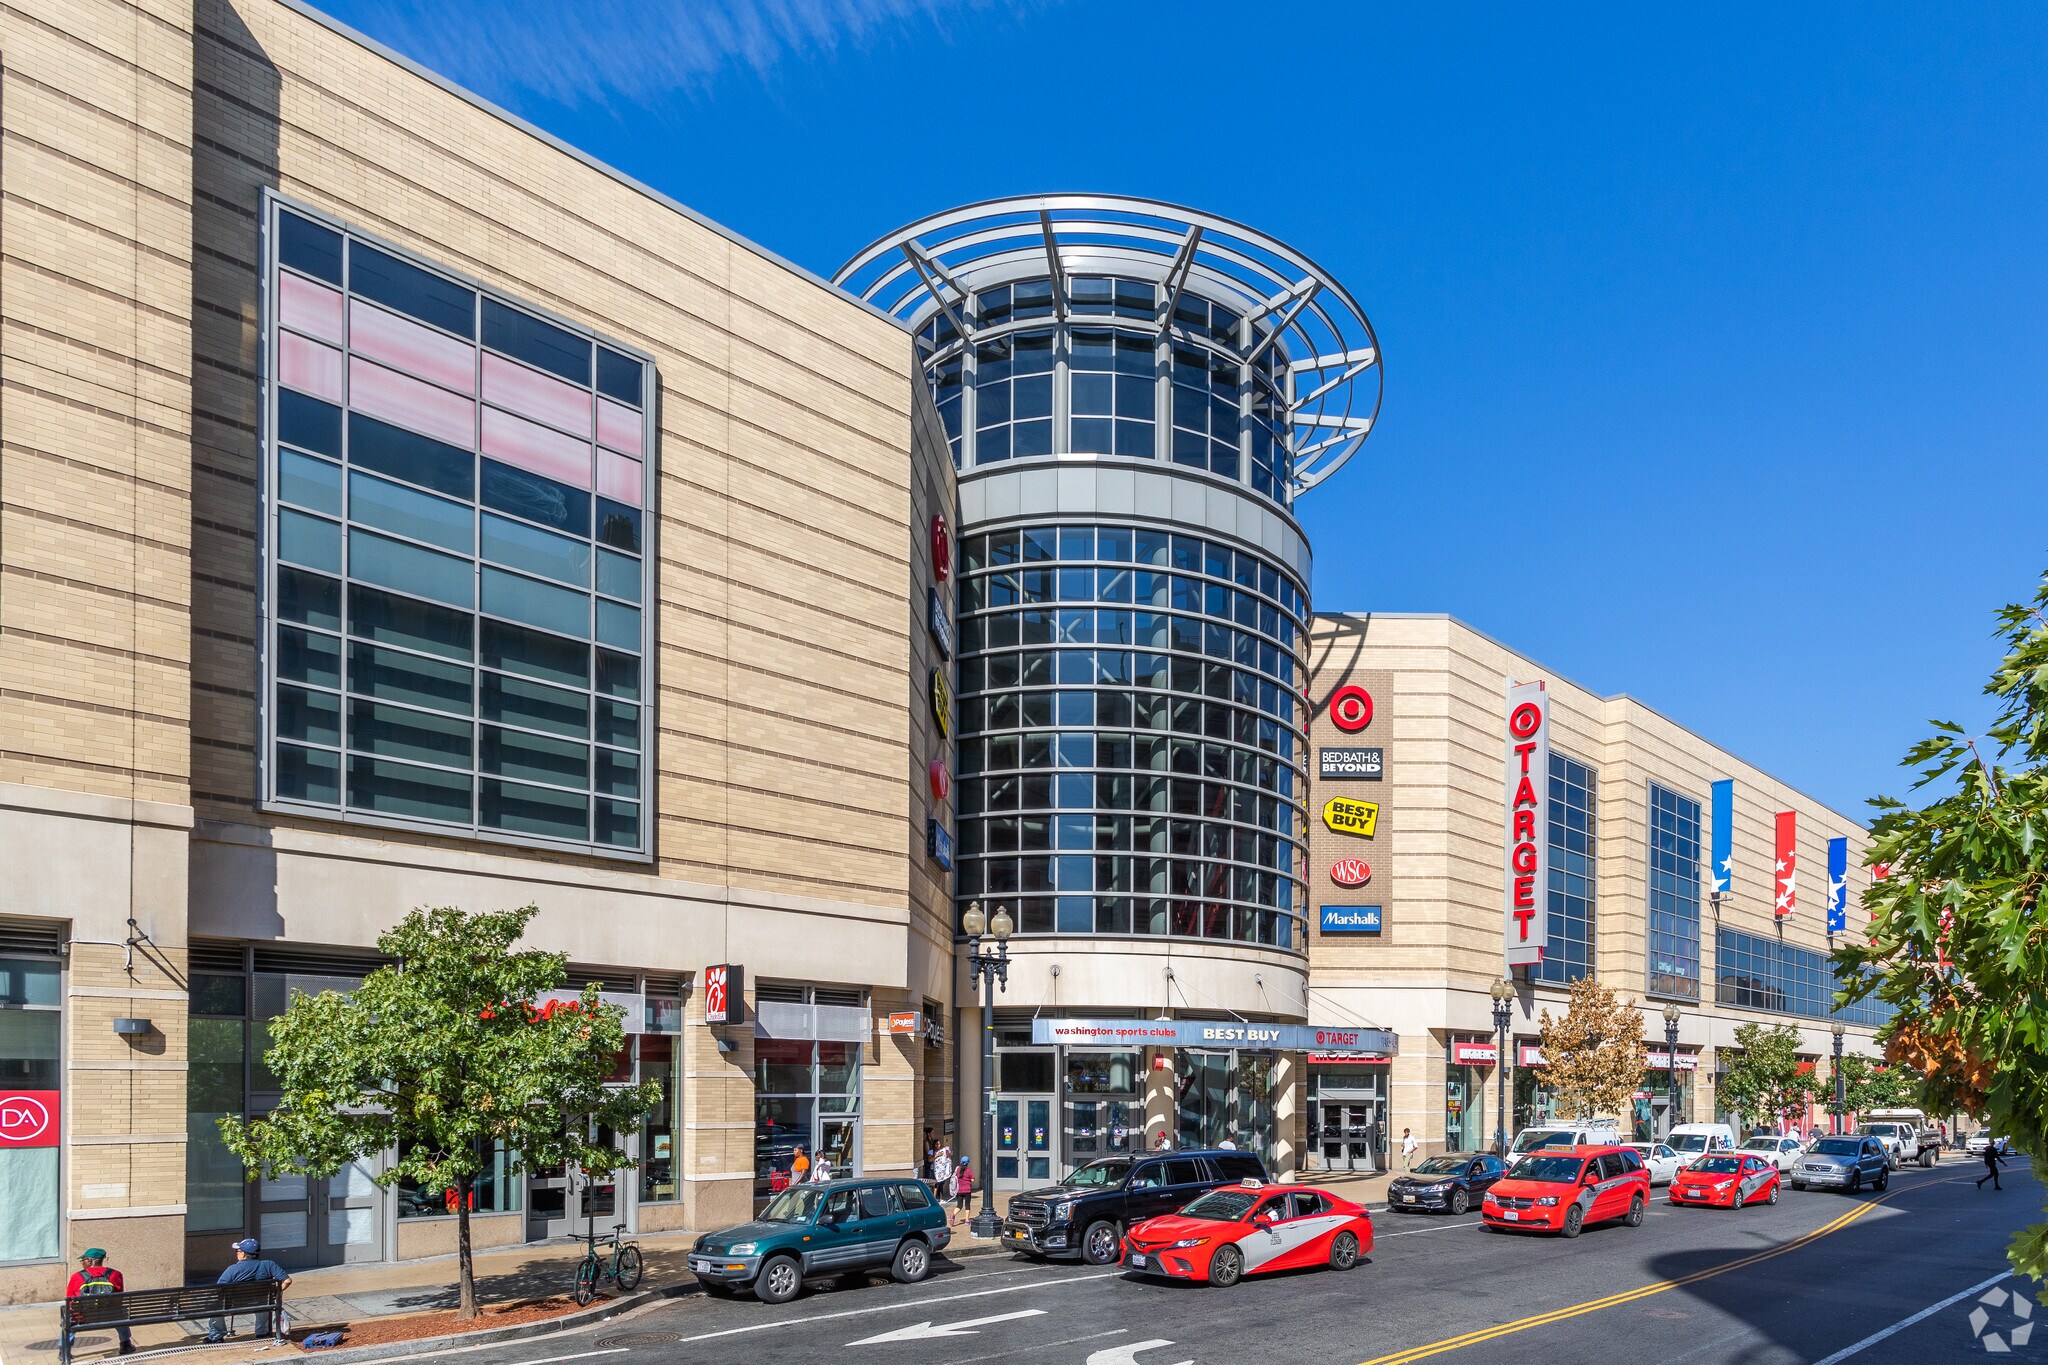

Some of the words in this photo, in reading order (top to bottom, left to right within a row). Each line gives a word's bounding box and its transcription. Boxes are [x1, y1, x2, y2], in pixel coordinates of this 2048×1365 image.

[1322, 752, 1343, 763] BED
[1343, 752, 1371, 763] BATH
[1371, 752, 1380, 763] &
[1322, 763, 1381, 772] BEYOND
[1332, 801, 1375, 819] BEST
[1332, 813, 1370, 829] BUY
[1512, 741, 1538, 940] TARGET
[1335, 859, 1366, 882] WSC
[1323, 912, 1380, 925] Marshalls
[1055, 1026, 1113, 1036] washington
[1115, 1028, 1148, 1037] sports
[1150, 1027, 1176, 1037] clubs
[1203, 1028, 1245, 1041] BEST
[1247, 1029, 1280, 1042] BUY
[1326, 1032, 1358, 1045] TARGET
[2, 1109, 38, 1127] DA
